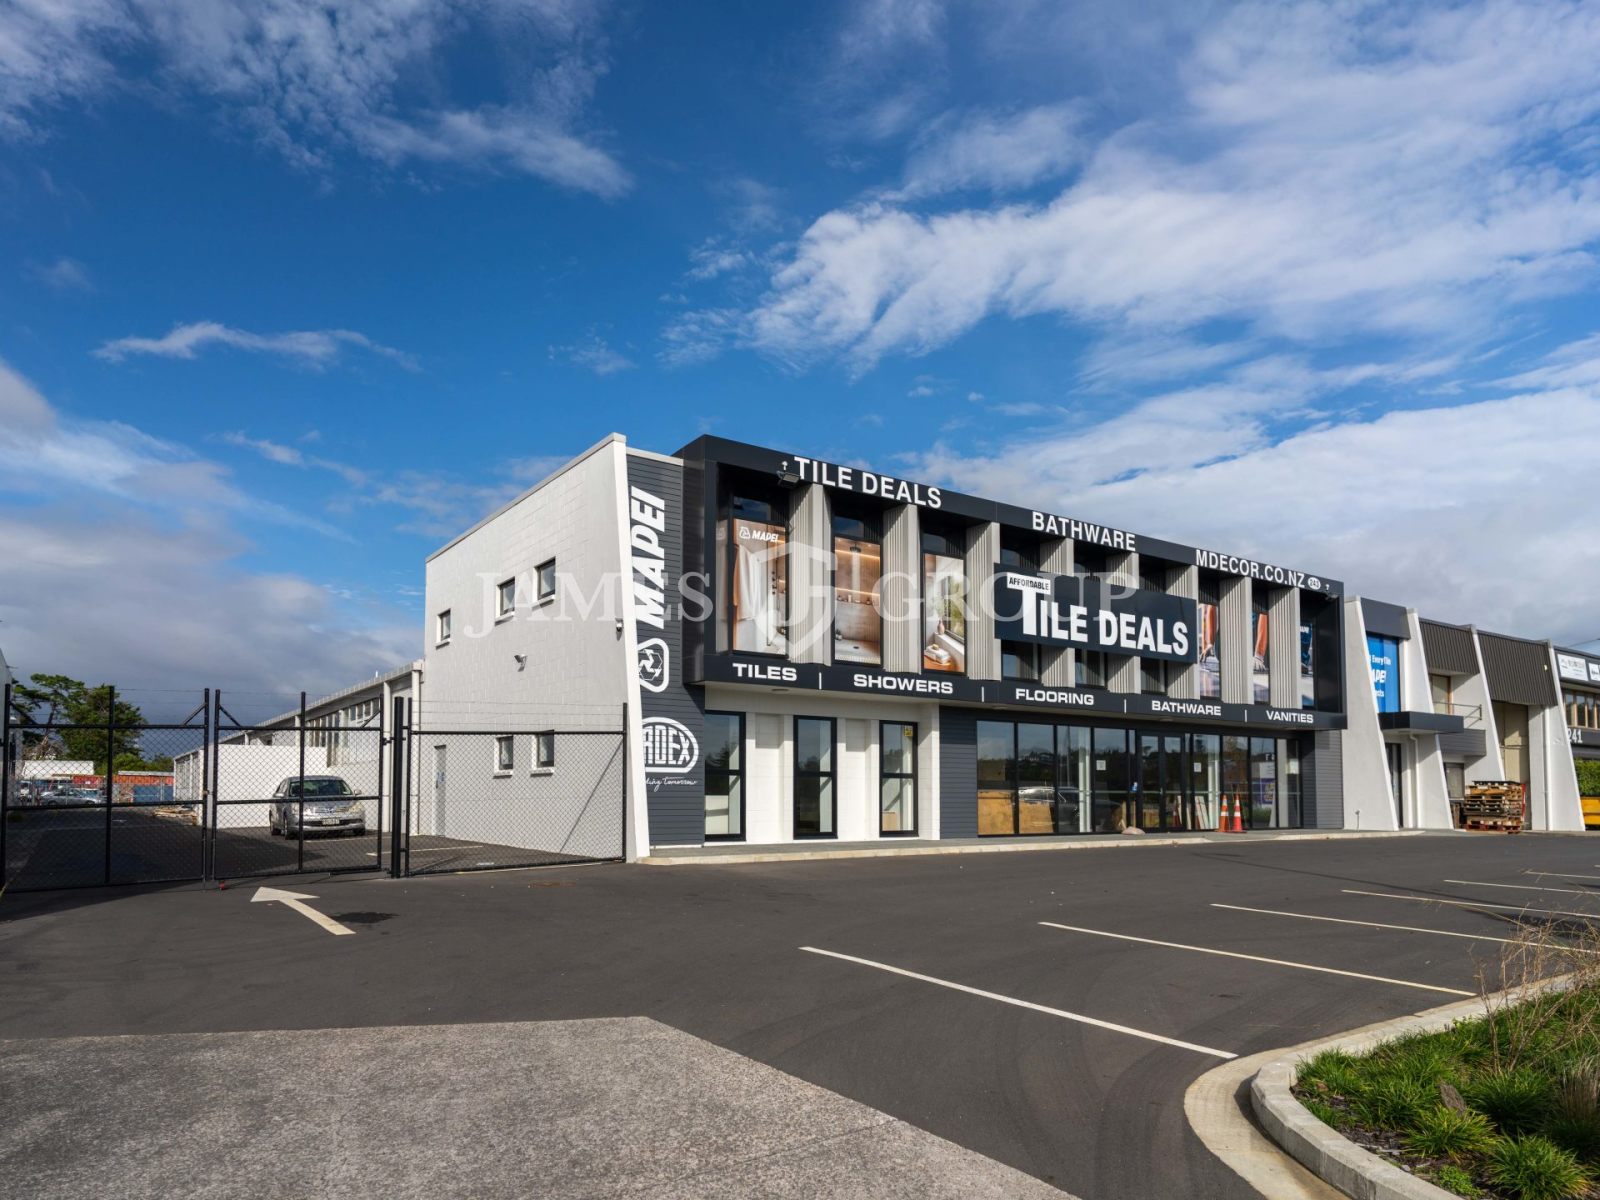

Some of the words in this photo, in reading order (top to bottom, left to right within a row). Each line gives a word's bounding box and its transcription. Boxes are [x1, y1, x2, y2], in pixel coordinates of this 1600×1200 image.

[794, 456, 853, 490] TILE
[861, 472, 942, 508] DEALS
[752, 530, 778, 542] MAPEI
[1032, 511, 1136, 551] BATHWARE
[631, 486, 666, 629] MAPEI
[1196, 550, 1305, 588] MDECOR.CO.NZ
[1009, 576, 1050, 591] AFFORDABLE
[1007, 573, 1088, 642] TILE
[1099, 610, 1188, 655] DEALS
[733, 664, 797, 681] TILES
[853, 674, 953, 694] SHOWERS
[1015, 689, 1094, 705] FLOORING
[1151, 700, 1221, 716] BATHWARE
[1266, 711, 1314, 723] VANITIES
[643, 725, 690, 764] RDEX
